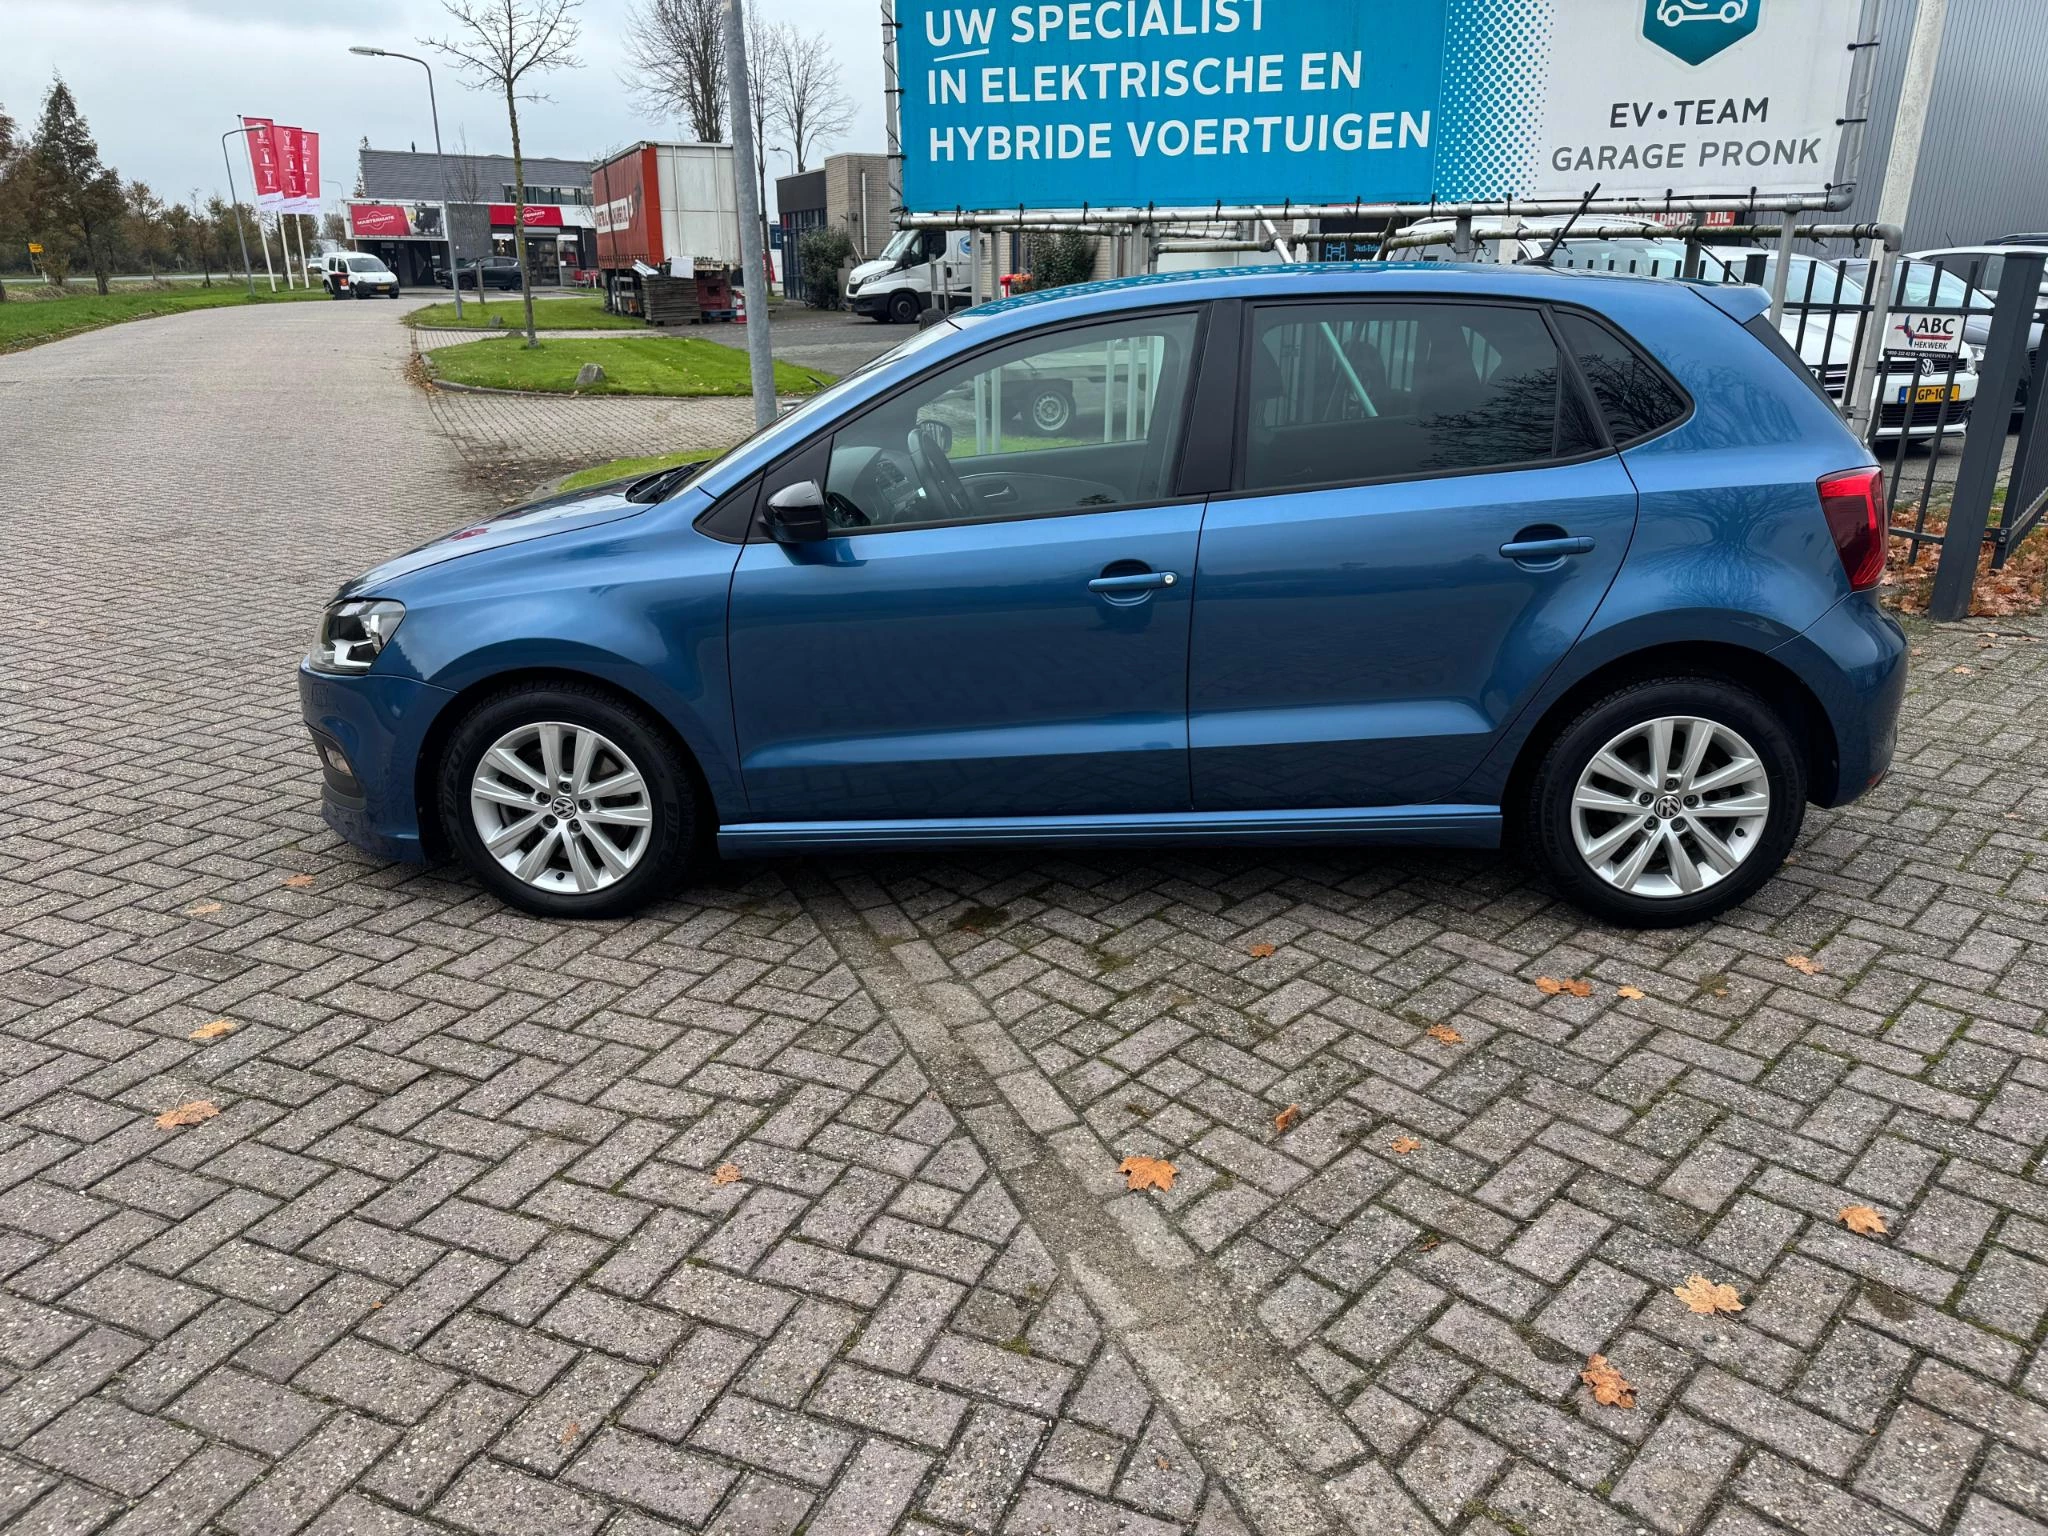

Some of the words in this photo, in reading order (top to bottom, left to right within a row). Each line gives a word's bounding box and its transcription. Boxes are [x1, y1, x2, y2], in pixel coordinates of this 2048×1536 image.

[925, 8, 997, 47] UW
[1011, 0, 1263, 43] SPECIALIST
[928, 69, 967, 105] IN
[981, 54, 1285, 103] ELEKTRISCHE
[1300, 50, 1363, 91] EN
[929, 122, 1112, 162] HYBRIDE
[1127, 110, 1431, 157] VOERTUIGEN
[1551, 142, 1687, 172] GARAGE
[1698, 137, 1822, 168] PRONK
[1914, 340, 1948, 350] HEKWERK
[1917, 317, 1955, 335] ABC
